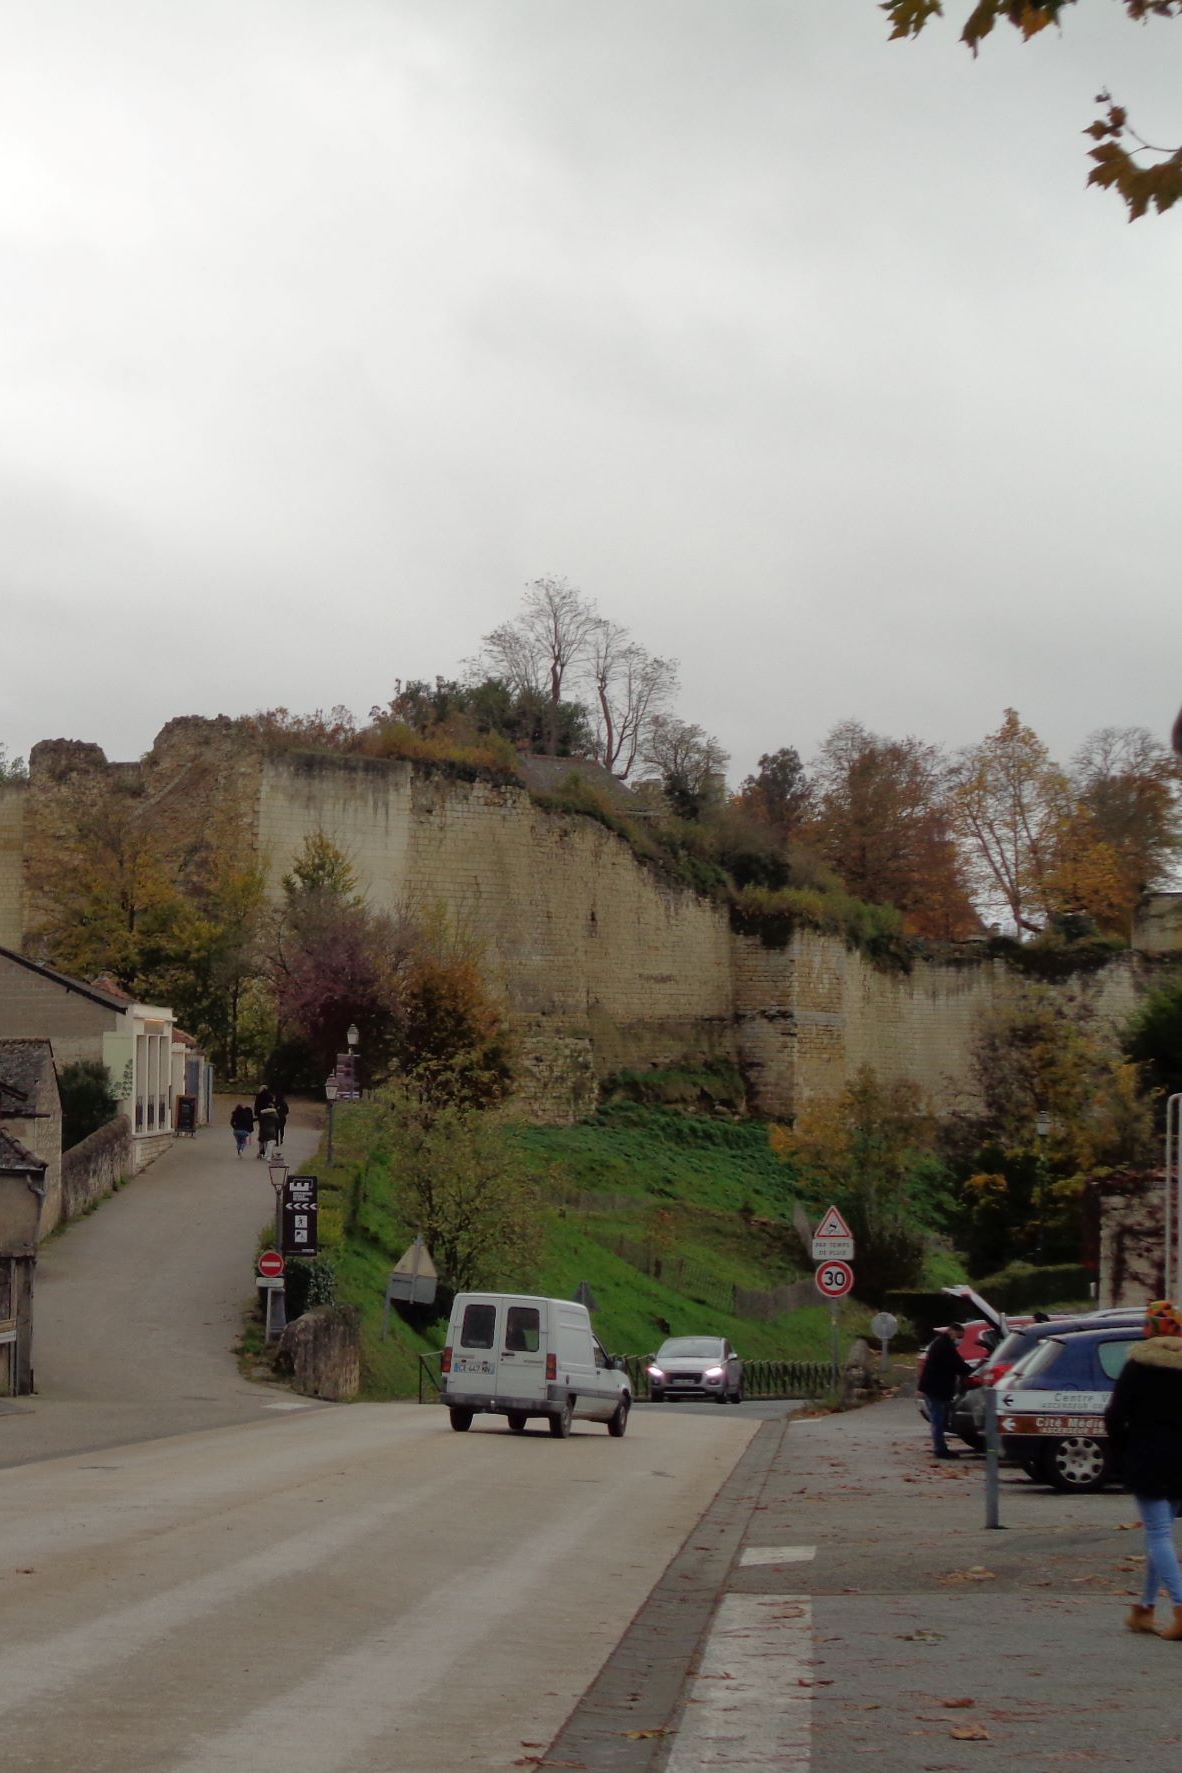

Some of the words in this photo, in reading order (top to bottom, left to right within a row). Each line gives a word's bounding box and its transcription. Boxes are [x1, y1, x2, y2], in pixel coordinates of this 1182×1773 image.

[824, 1271, 846, 1287] 30
[1054, 1392, 1095, 1402] Centre
[1035, 1417, 1062, 1427] Cité
